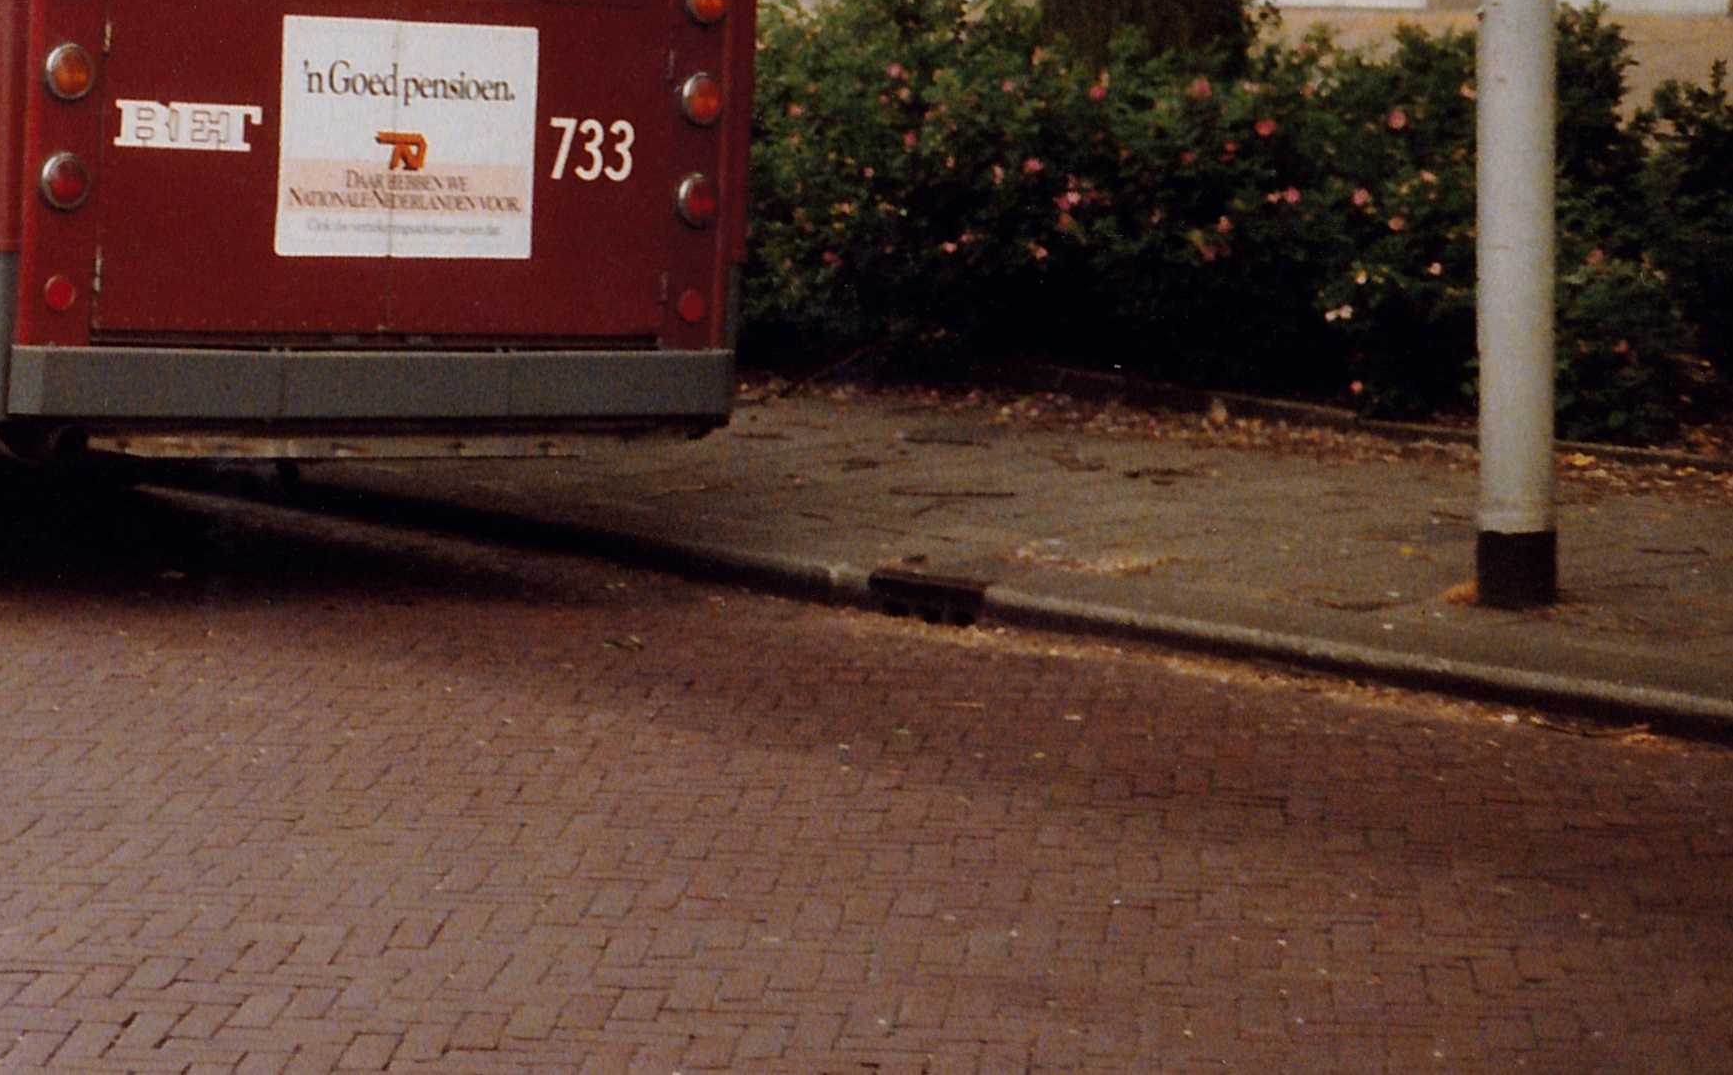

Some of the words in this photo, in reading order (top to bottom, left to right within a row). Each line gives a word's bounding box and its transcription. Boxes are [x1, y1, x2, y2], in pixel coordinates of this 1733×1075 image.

[303, 59, 323, 94] 'n
[328, 59, 399, 97] Goed
[402, 70, 516, 107] pensioen.
[549, 116, 636, 182] 733
